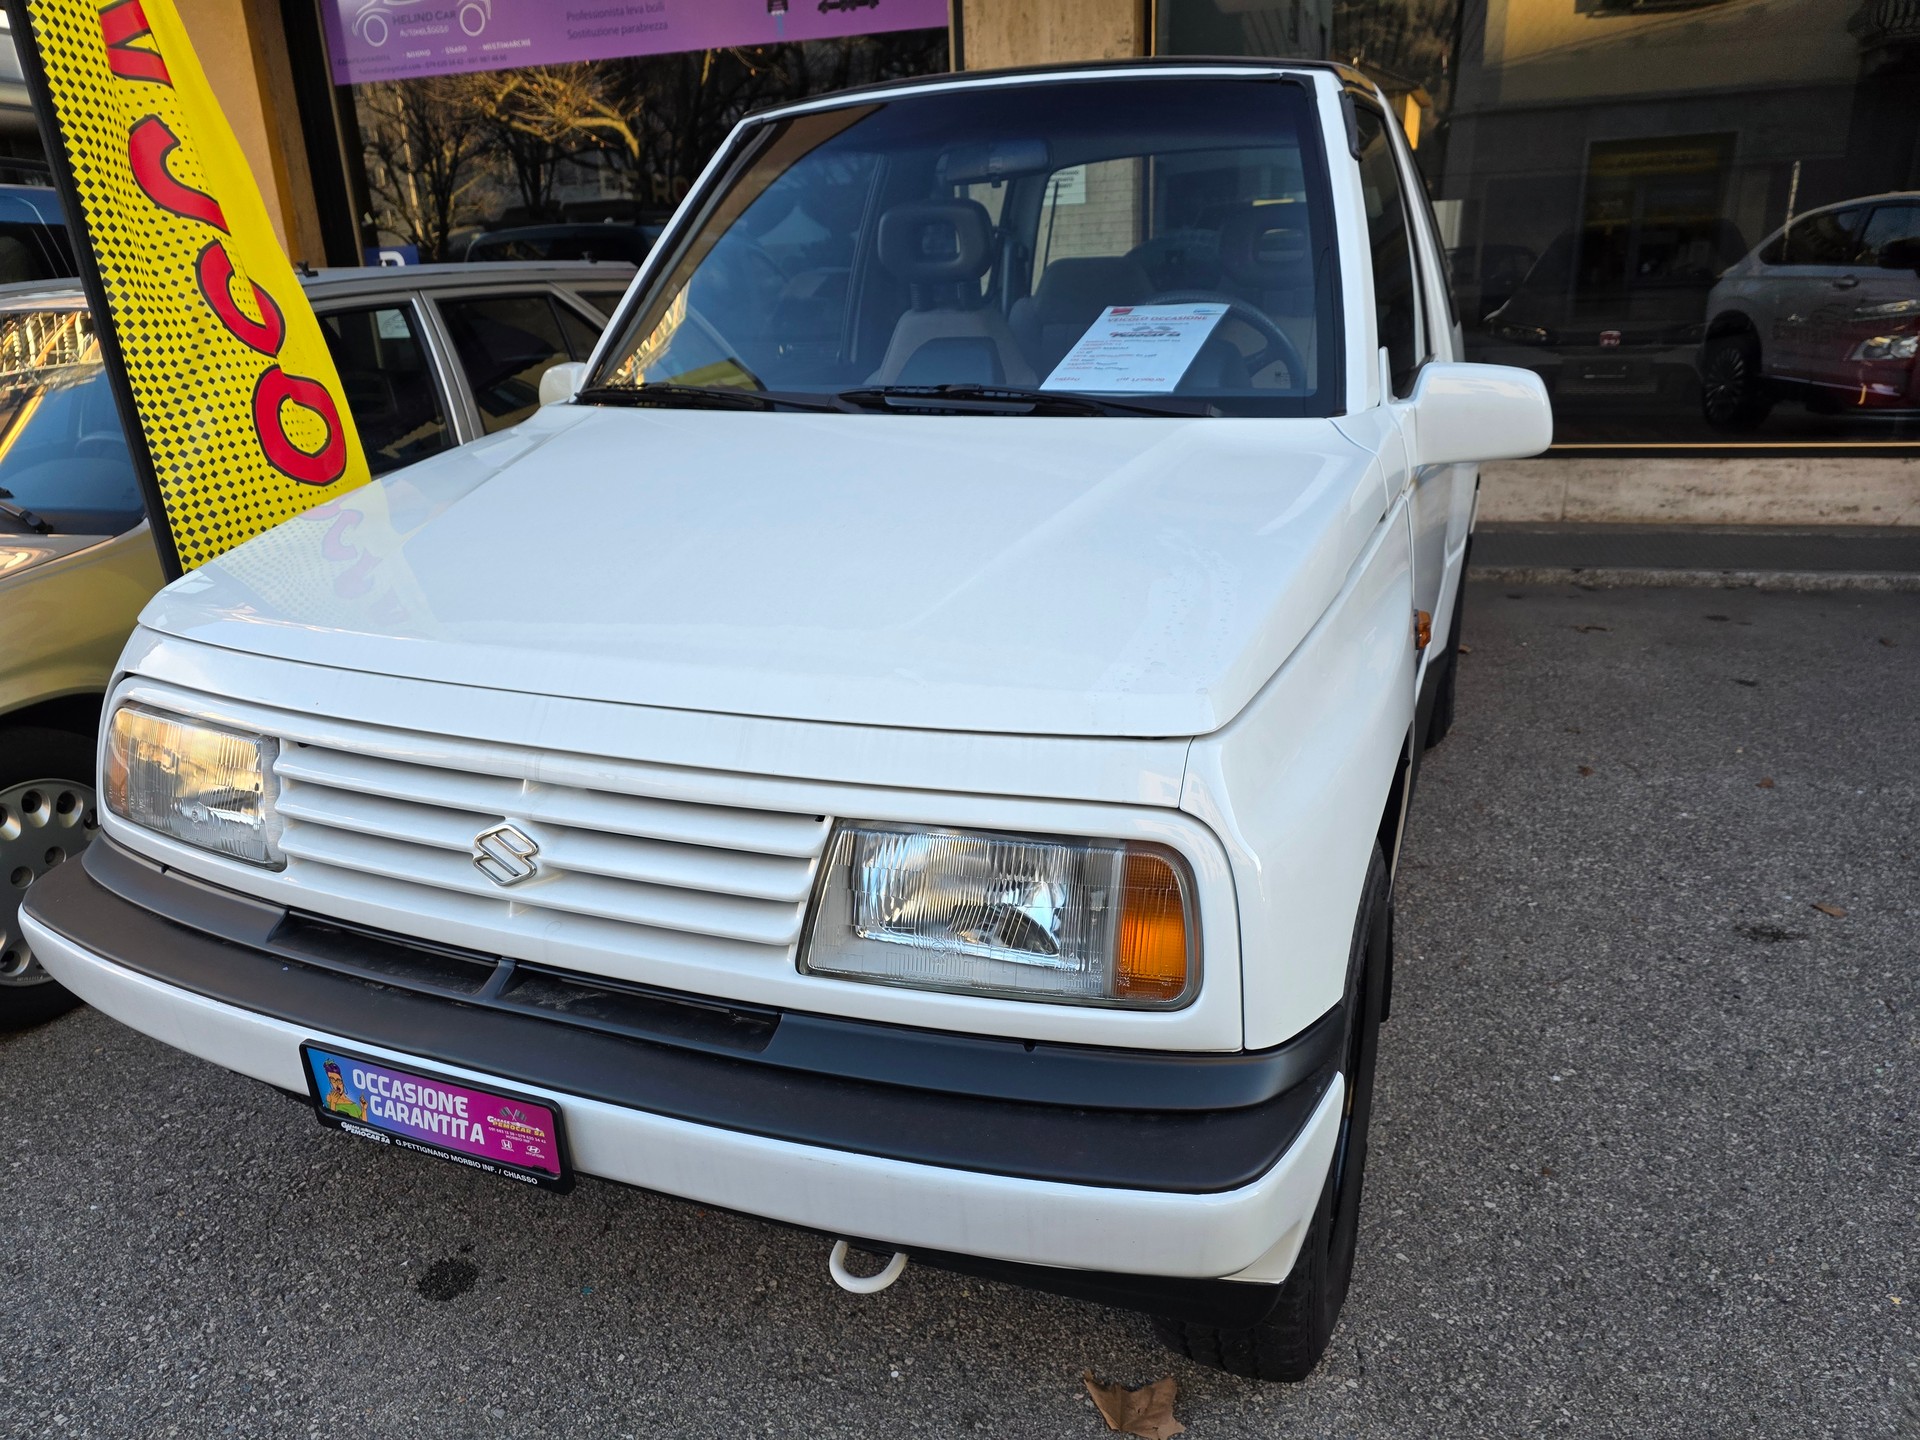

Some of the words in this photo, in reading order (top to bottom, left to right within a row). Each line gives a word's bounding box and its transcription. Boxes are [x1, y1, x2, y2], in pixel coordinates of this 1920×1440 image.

[392, 11, 433, 25] HELIND
[434, 10, 457, 22] CAR
[566, 7, 625, 21] Professionista
[626, 5, 644, 15] leva
[567, 26, 620, 39] Sostituzione
[621, 22, 669, 36] parabrezza
[1107, 315, 1149, 323] VEICOLO
[1150, 314, 1208, 322] OCCASIONE
[352, 1068, 469, 1118] OCCASIONE
[369, 1095, 486, 1145] GARANTITA
[345, 1126, 381, 1141] PEMOCAR
[381, 1137, 391, 1145] SA
[492, 1121, 532, 1134] PEMOCAR
[533, 1129, 545, 1138] SA
[395, 1139, 450, 1160] G.PETTIGNANO
[450, 1154, 482, 1169] MORBIO
[481, 1163, 498, 1174] INF.
[503, 1170, 538, 1185] CHIASSO
